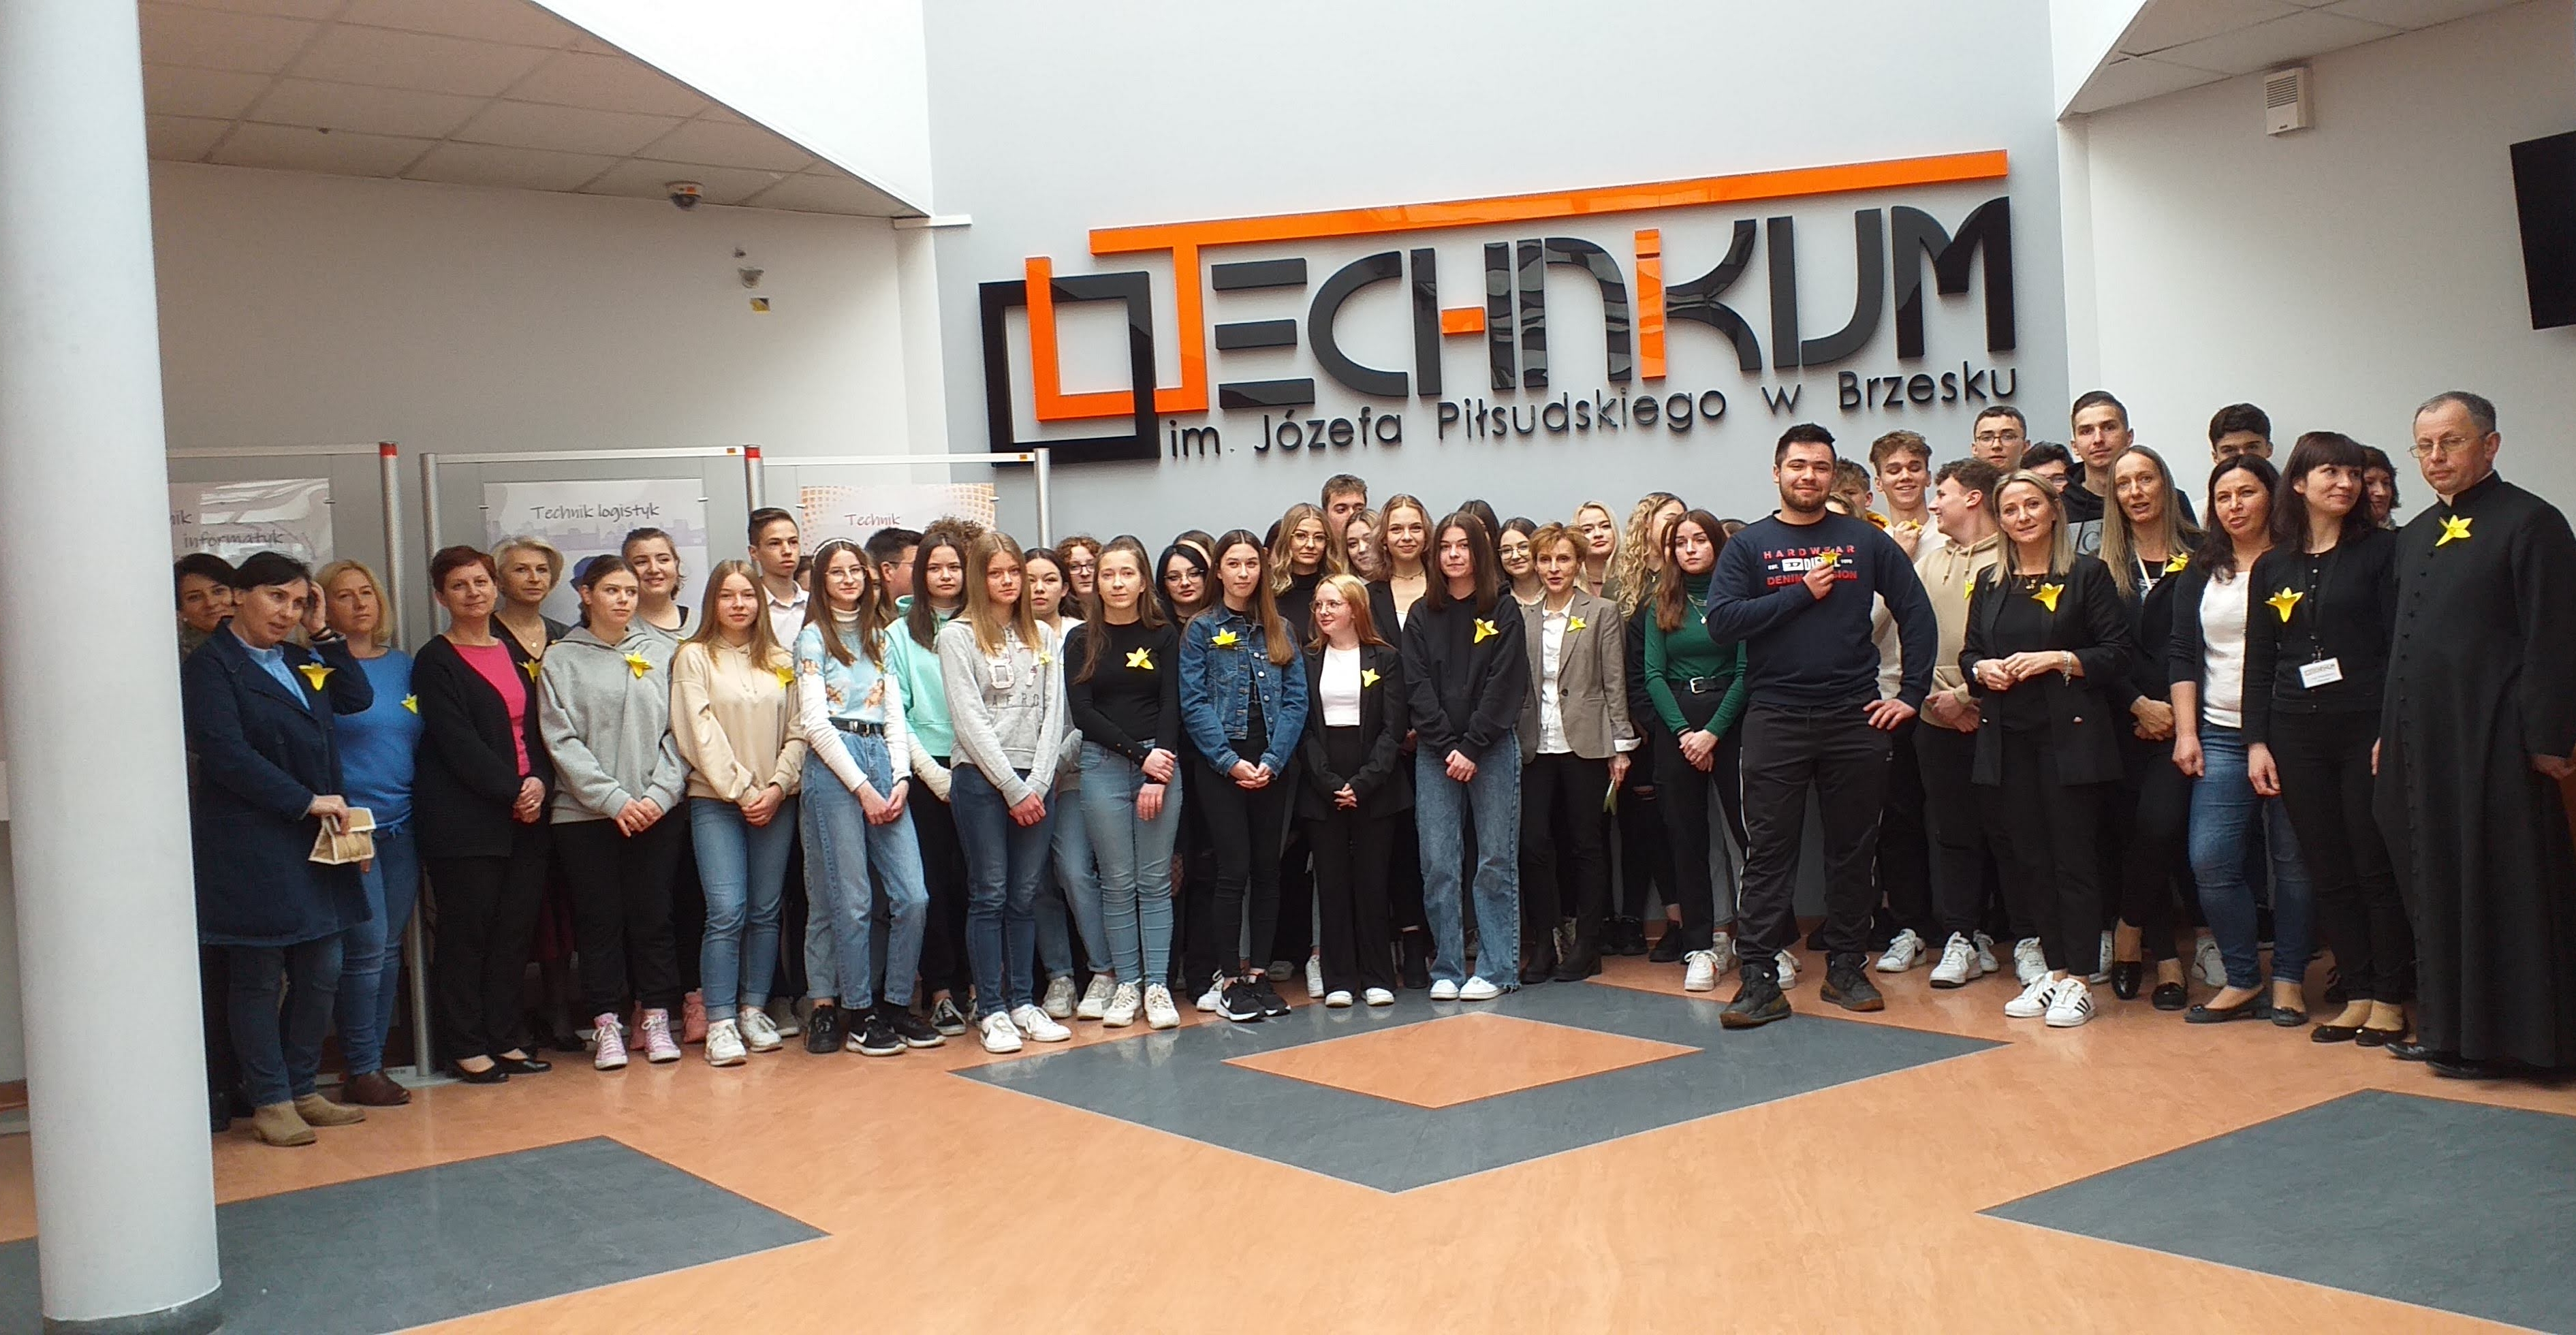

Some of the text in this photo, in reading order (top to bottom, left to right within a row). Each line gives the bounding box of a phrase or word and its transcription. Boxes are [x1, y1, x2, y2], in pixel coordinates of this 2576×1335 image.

[1170, 360, 2017, 458] im. Józefa Piłsudskiego w Brzesku
[530, 503, 659, 522] Technik logistyk
[844, 512, 900, 527] Technik
[183, 529, 284, 548] informatyk
